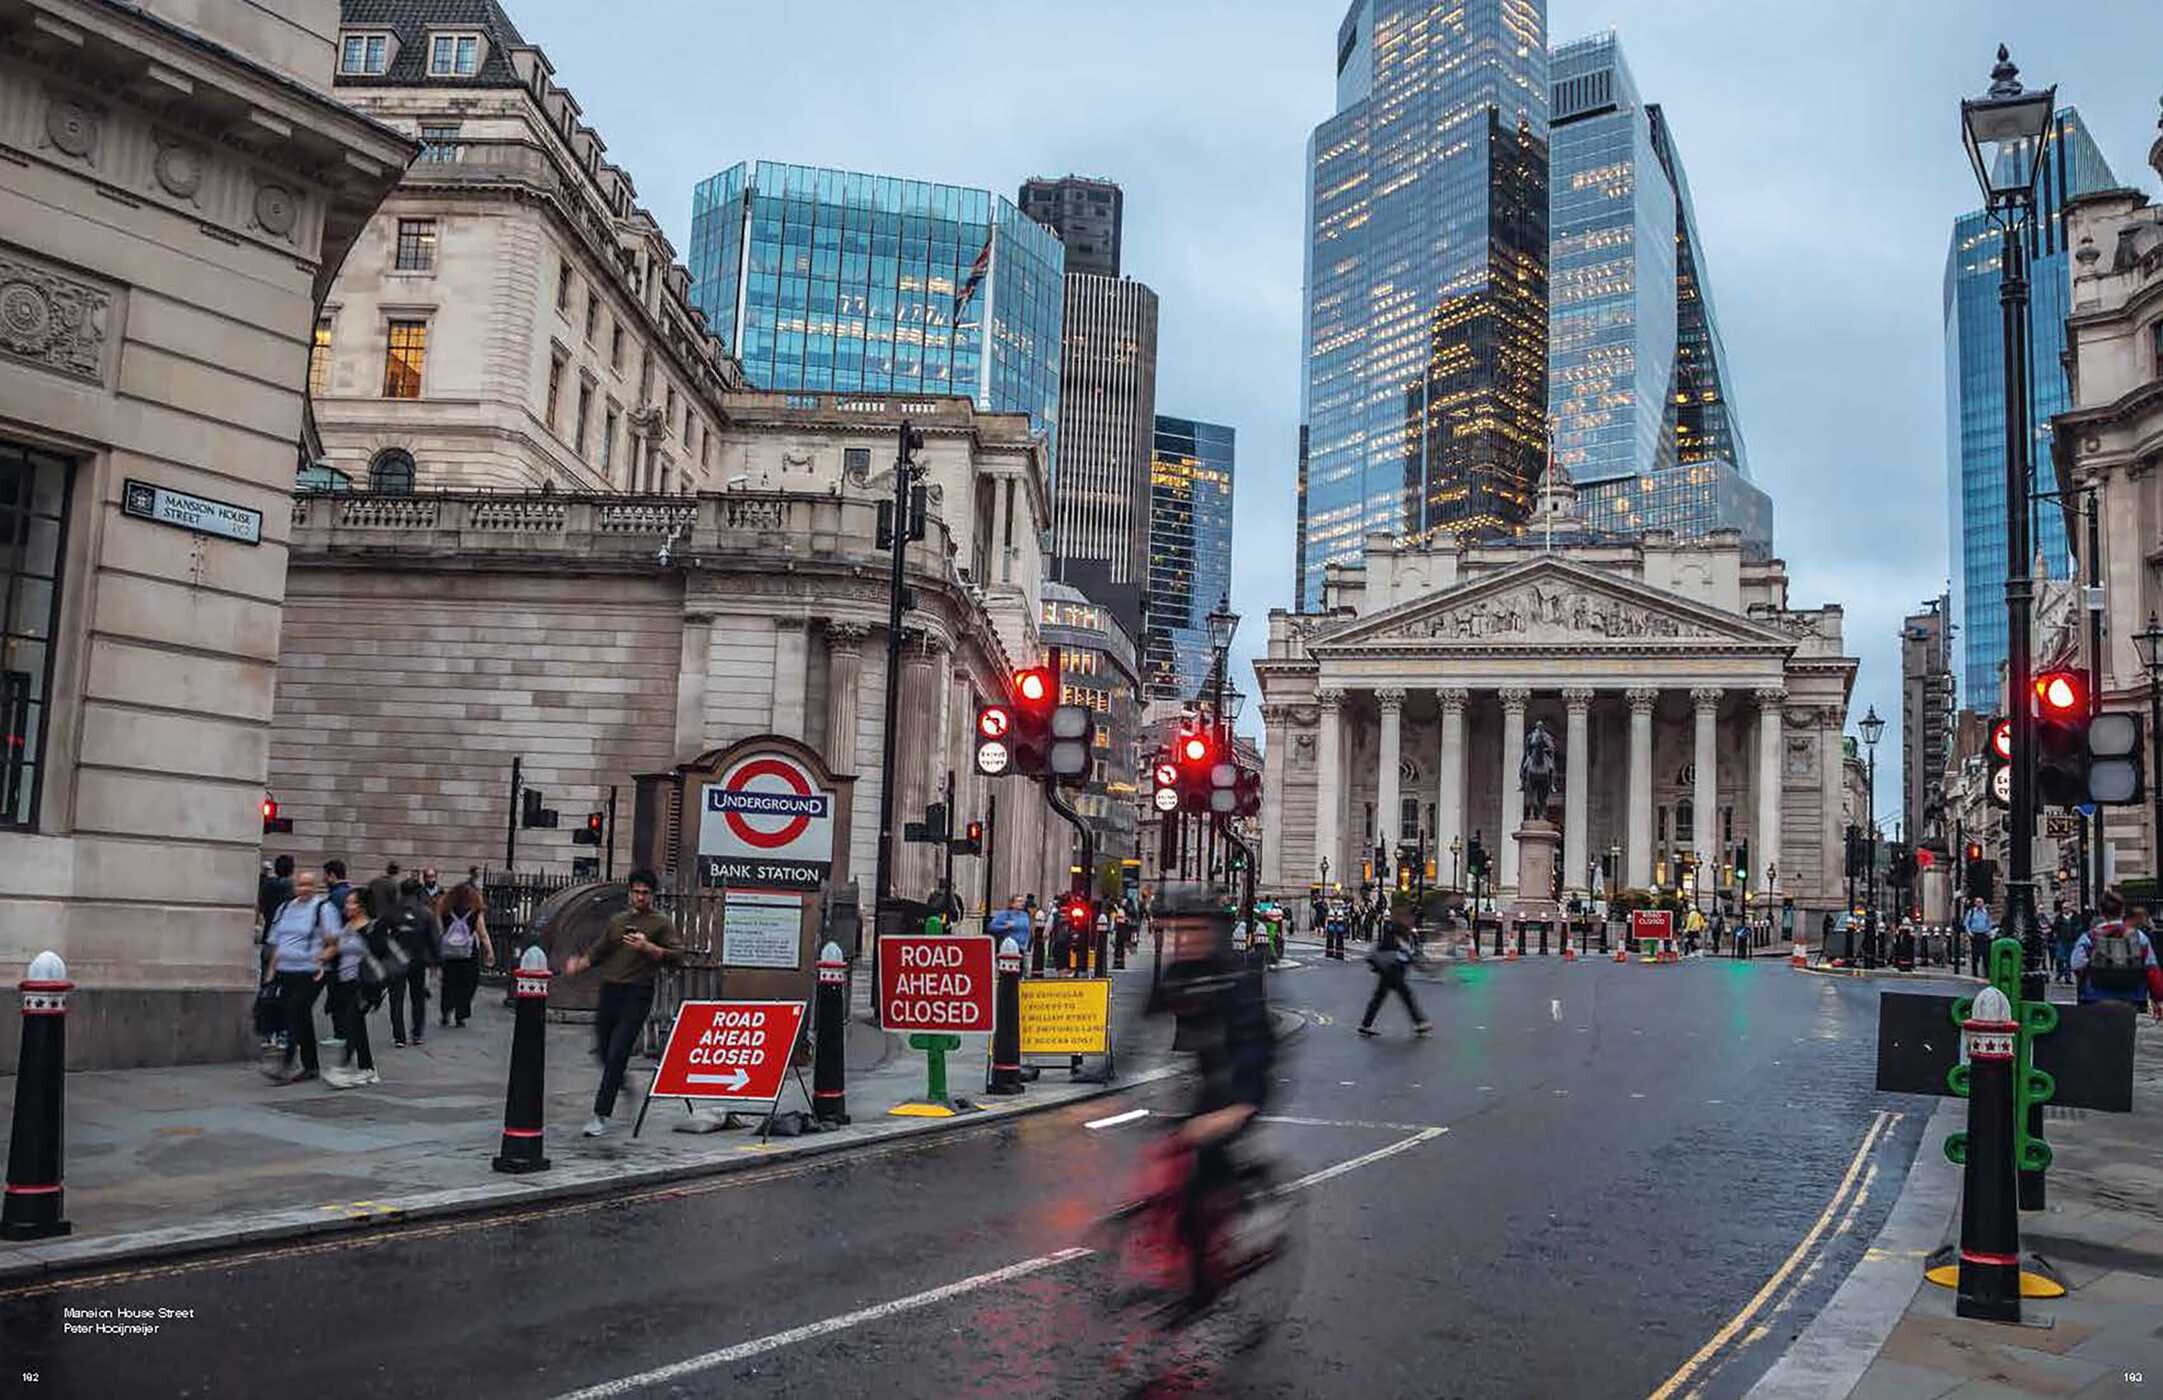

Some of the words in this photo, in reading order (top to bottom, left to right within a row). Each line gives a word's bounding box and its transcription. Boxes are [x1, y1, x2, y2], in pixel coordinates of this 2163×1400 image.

[163, 508, 201, 524] STREET
[164, 496, 215, 515] MANSION
[218, 510, 251, 523] HOUSE
[714, 793, 822, 814] UNDERGROUND
[710, 864, 751, 878] BANK
[757, 866, 819, 881] STATION
[901, 945, 963, 967] ROAD
[895, 973, 972, 996] AHEAD
[712, 1011, 766, 1027] ROAD
[891, 1000, 979, 1023] CLOSED
[699, 1030, 766, 1046] AHEAD
[688, 1048, 765, 1065] CLOSED
